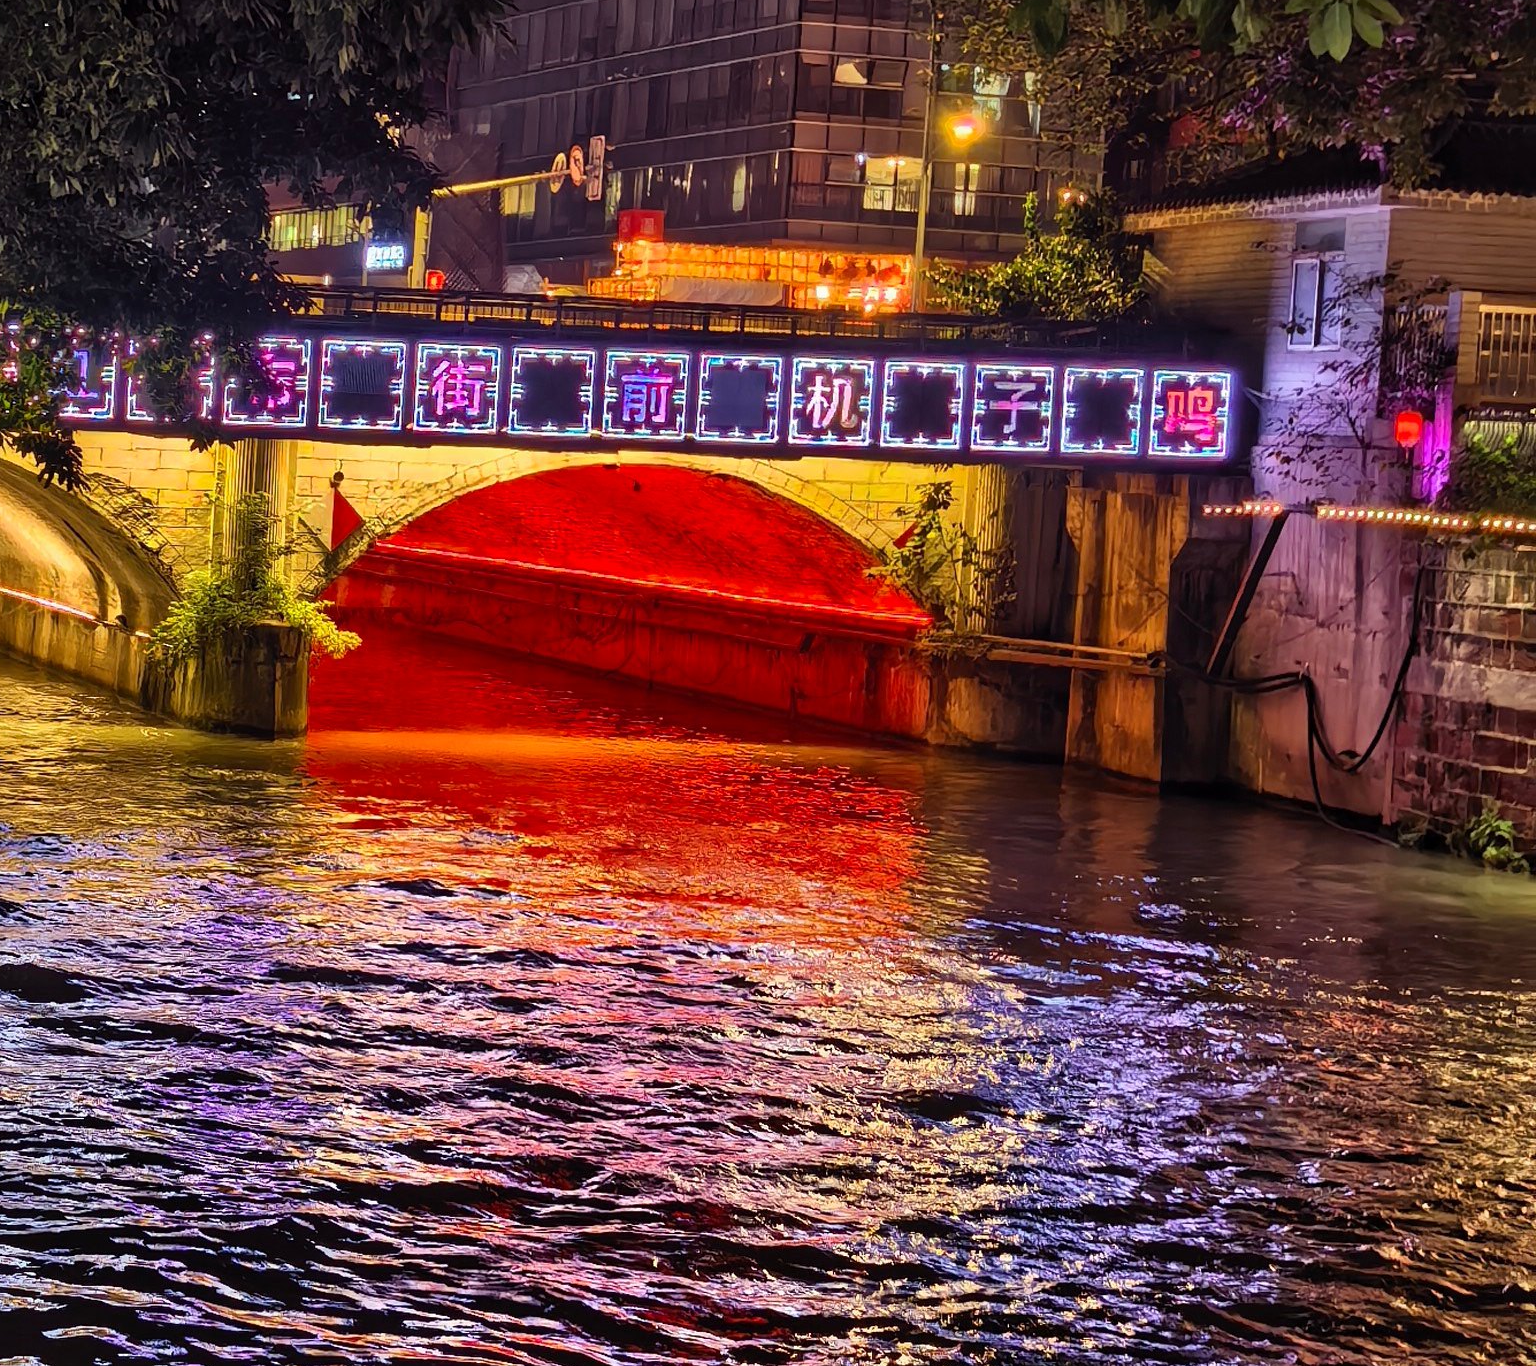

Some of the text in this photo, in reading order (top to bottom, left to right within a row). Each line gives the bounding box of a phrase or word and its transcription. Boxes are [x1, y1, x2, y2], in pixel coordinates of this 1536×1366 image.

[432, 359, 487, 416] 街
[621, 369, 674, 424] 前
[805, 375, 858, 431] 机
[990, 382, 1038, 434] 子
[1163, 388, 1217, 442] 鸣
